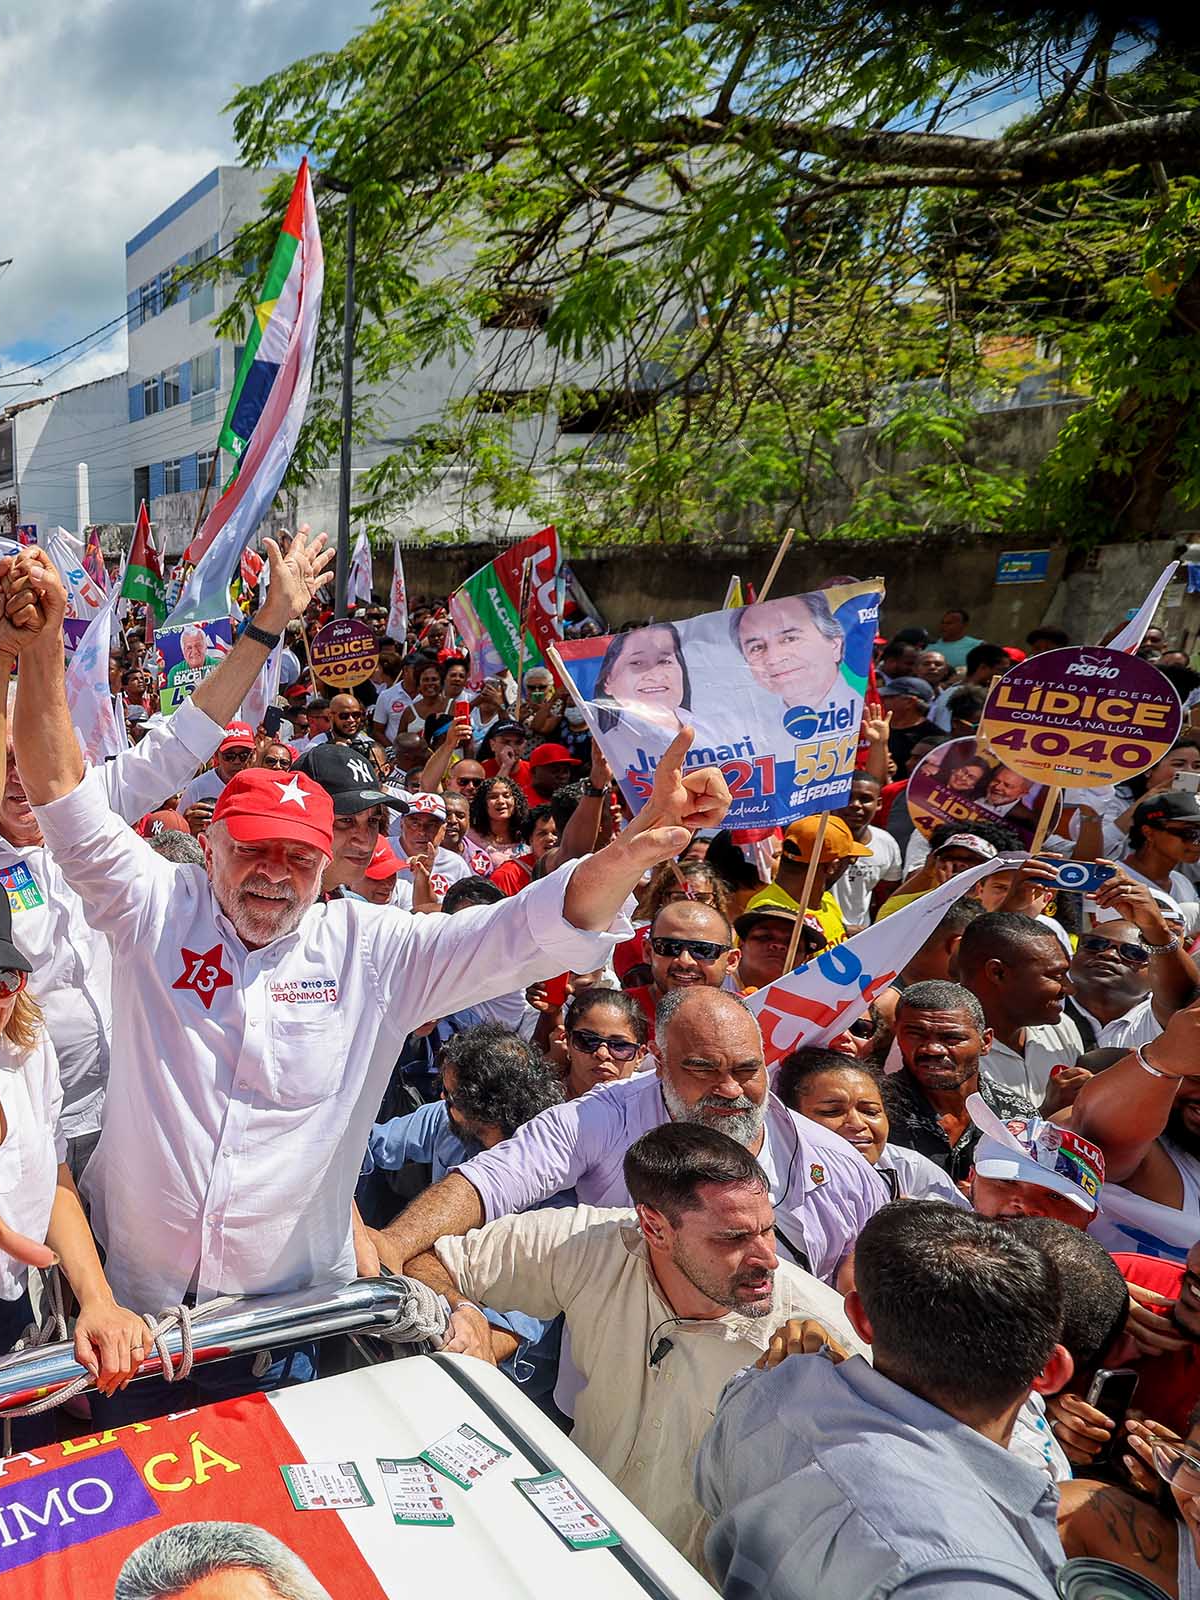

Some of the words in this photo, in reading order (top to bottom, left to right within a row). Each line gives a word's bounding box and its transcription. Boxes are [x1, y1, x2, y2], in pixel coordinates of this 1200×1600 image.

[313, 638, 375, 659] LÍDICE
[173, 668, 216, 686] BACELA
[319, 658, 376, 677] 4040
[1065, 662, 1121, 680] PSB40
[1001, 676, 1088, 693] DEPUTADA
[1097, 687, 1174, 704] FEDERAL
[995, 685, 1172, 728] LÍDICE
[1011, 711, 1043, 722] COM
[1046, 716, 1082, 728] LULA
[1085, 721, 1106, 731] NA
[1108, 725, 1145, 736] LUTA
[630, 735, 757, 773] Jumari
[990, 728, 1153, 769] 4040
[345, 758, 374, 784] NY
[625, 754, 777, 800] 521
[788, 776, 853, 808] #ÉFEDERA
[927, 789, 992, 822] LÍDI
[477, 860, 485, 868] 13
[435, 880, 443, 889] 13
[186, 958, 219, 992] 13
[323, 980, 336, 988] 555
[1073, 1138, 1103, 1171] LUL
[1080, 1172, 1097, 1197] 13
[142, 1431, 242, 1494] CÁ
